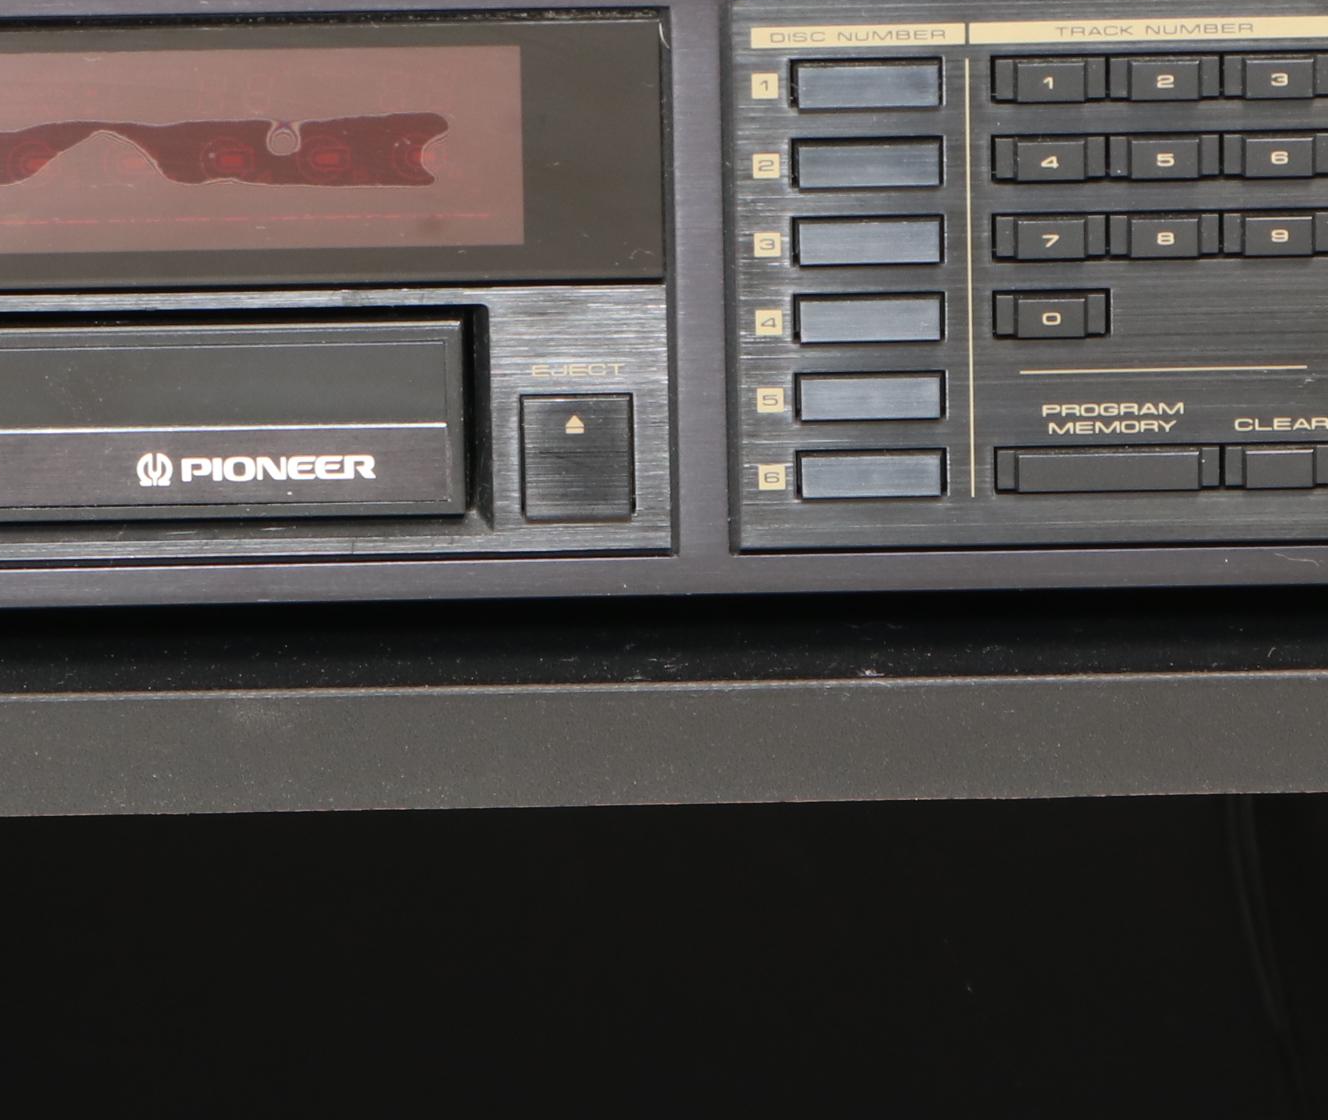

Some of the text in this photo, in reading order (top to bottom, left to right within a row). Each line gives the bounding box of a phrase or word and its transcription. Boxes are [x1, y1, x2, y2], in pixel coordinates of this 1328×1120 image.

[769, 28, 947, 44] DISC NUMBER
[1055, 22, 1253, 38] TRACK NUMBER
[758, 78, 771, 92] 1
[1043, 77, 1053, 89] 1
[1157, 75, 1174, 88] 2
[1271, 73, 1288, 86] 3
[1041, 156, 1059, 168] 4
[1157, 153, 1175, 166] 5
[1270, 151, 1288, 164] 6
[757, 159, 774, 173] 2
[1042, 234, 1059, 247] 7
[1157, 232, 1175, 245] 8
[1271, 229, 1289, 242] 9
[758, 237, 776, 251] 3
[760, 315, 777, 330] 4
[1042, 312, 1061, 325] 0
[531, 364, 624, 377] EJECT
[761, 393, 779, 407] 5
[1042, 402, 1184, 417] PROGRAM
[1049, 420, 1176, 434] MEMORY
[1234, 417, 1328, 431] CLEAR
[181, 454, 376, 483] PIONEER
[763, 470, 780, 484] 6
